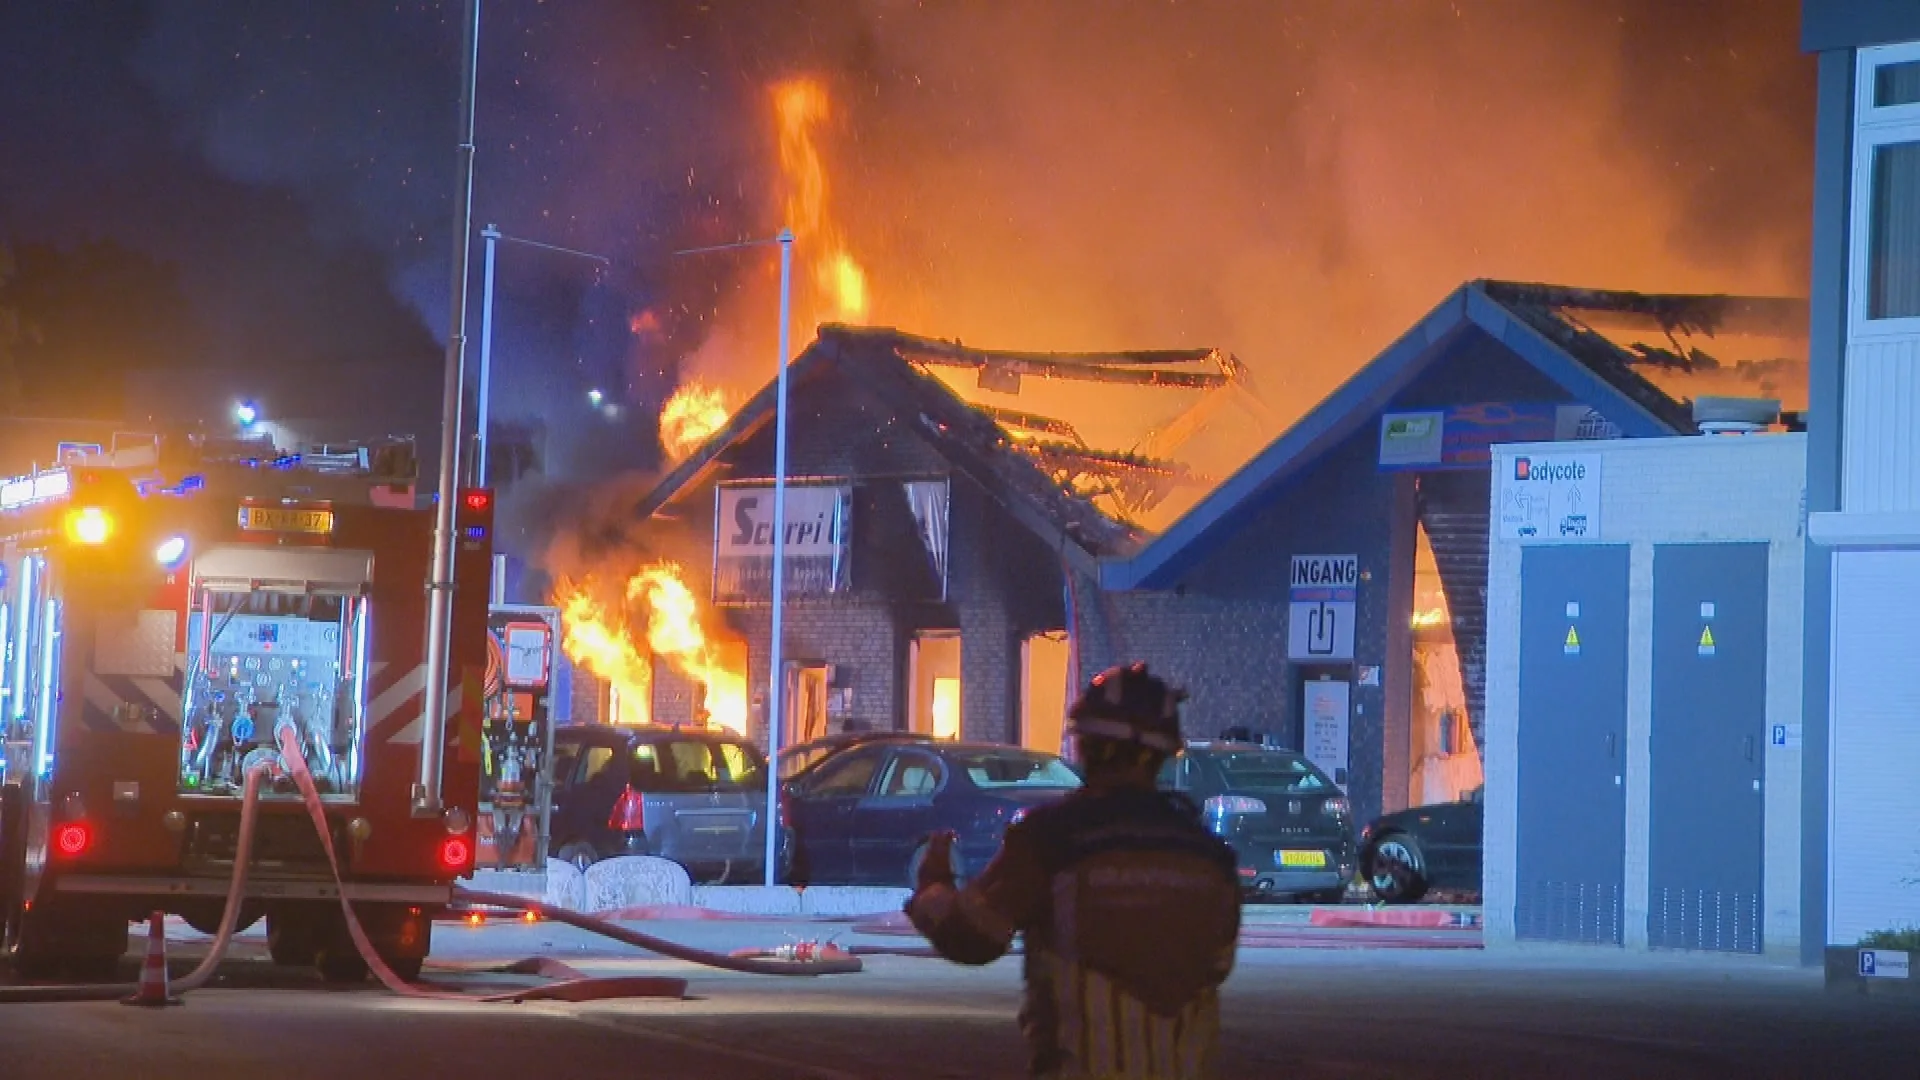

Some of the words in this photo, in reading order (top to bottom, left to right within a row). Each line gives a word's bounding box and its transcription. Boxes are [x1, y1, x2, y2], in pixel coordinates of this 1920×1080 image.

[1515, 456, 1586, 484] Bodycote
[1292, 560, 1356, 585] INGANG
[1775, 727, 1784, 743] P
[1863, 953, 1873, 971] P
